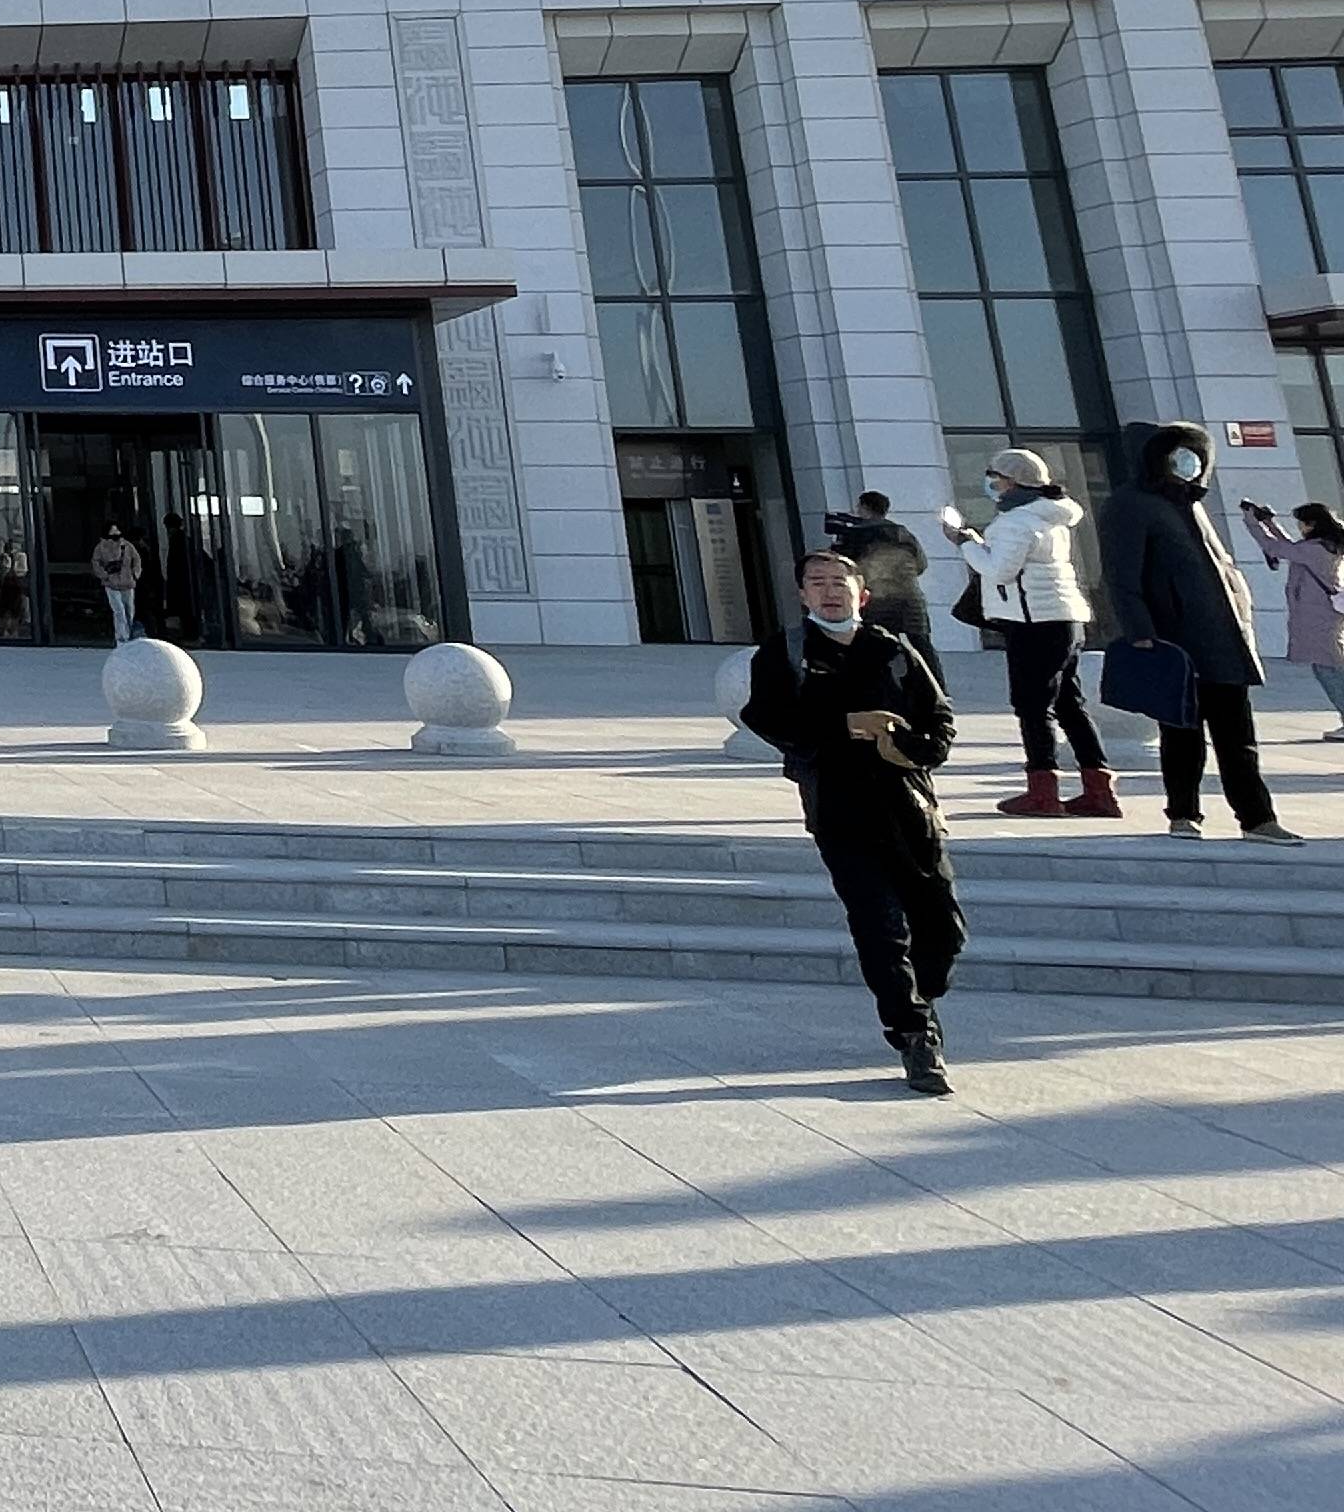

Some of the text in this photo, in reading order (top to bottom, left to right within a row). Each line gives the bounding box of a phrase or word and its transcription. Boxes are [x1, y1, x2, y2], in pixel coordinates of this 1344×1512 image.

[107, 340, 193, 367] 进站口
[108, 371, 184, 386] Entrance
